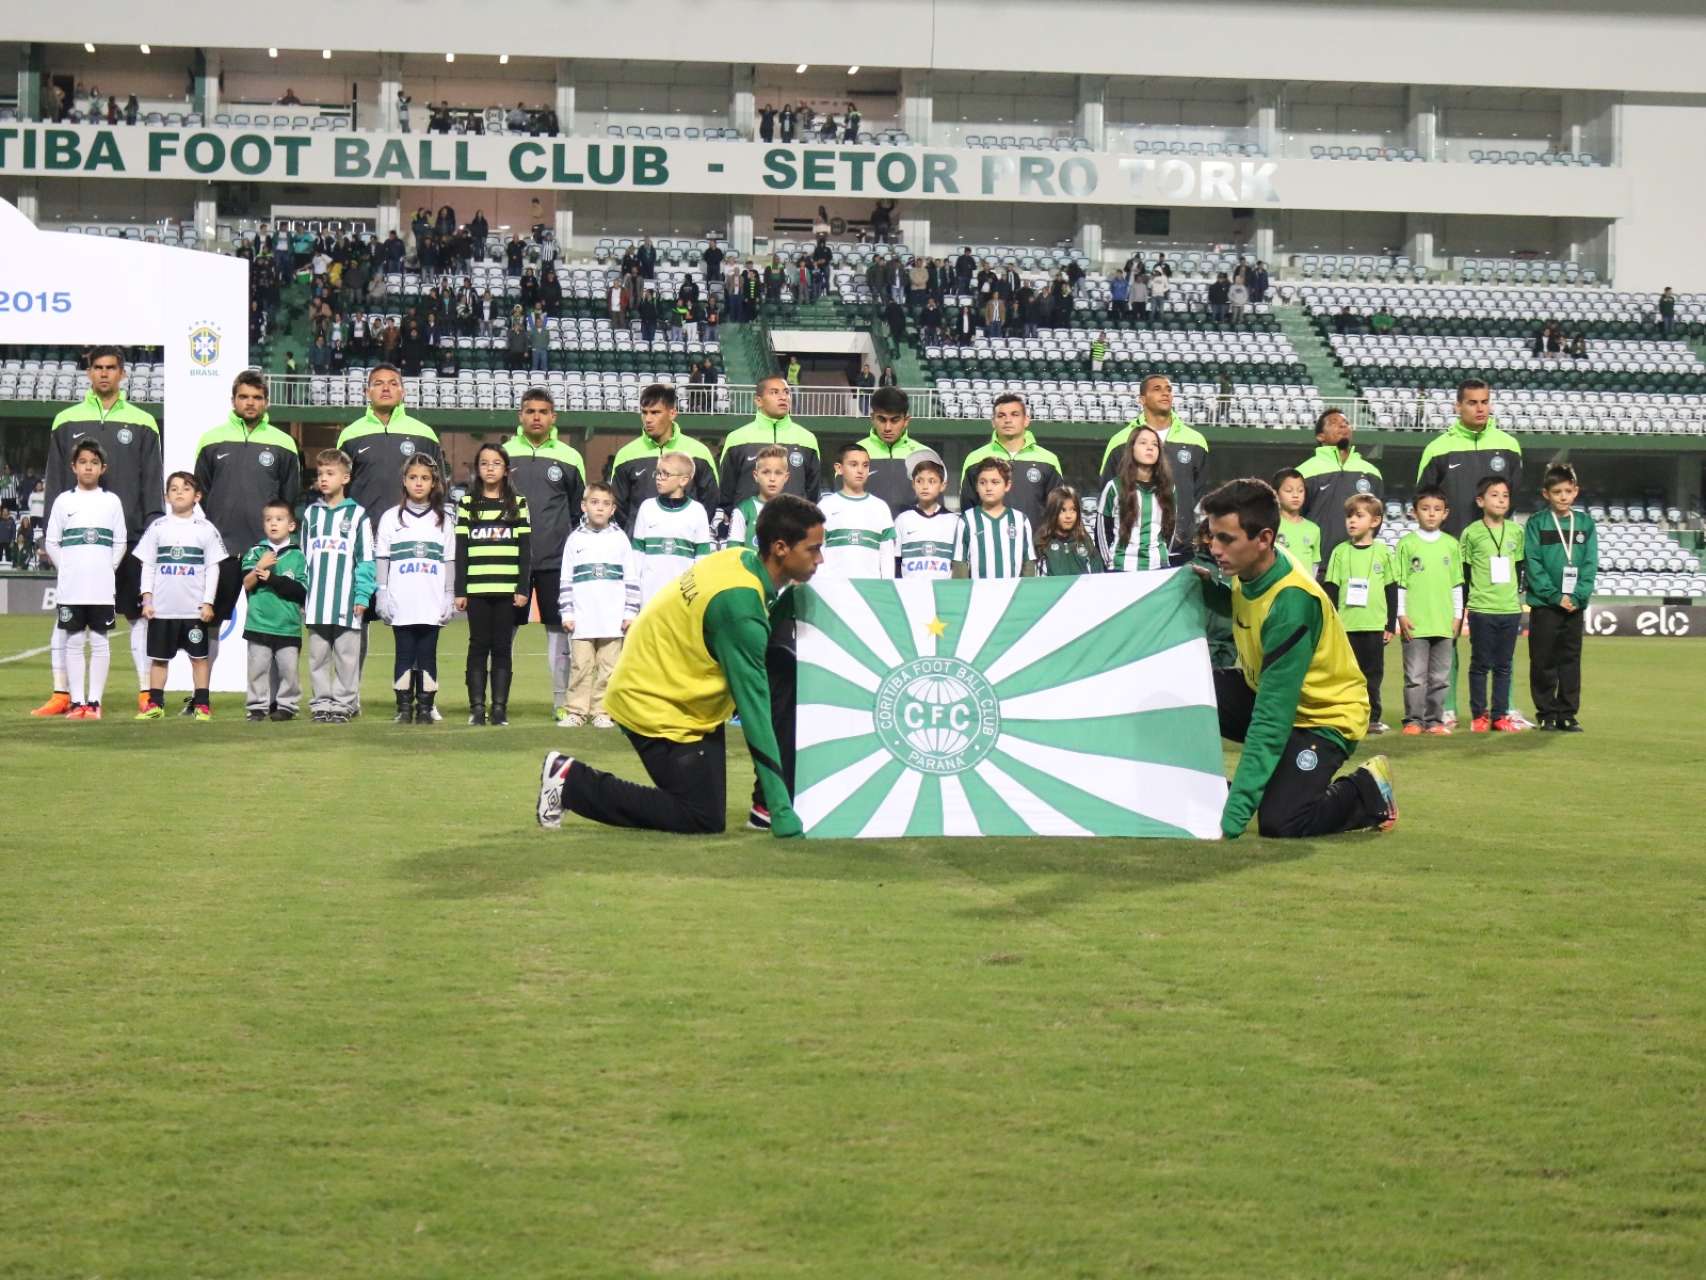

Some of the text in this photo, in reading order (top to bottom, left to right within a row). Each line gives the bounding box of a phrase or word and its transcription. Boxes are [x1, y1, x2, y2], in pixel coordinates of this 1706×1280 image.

[147, 131, 312, 176] FOOT
[333, 137, 487, 182] BALL
[508, 142, 669, 186] CLUB
[762, 148, 960, 194] SETOR
[981, 155, 1098, 197] PRO
[1118, 158, 1281, 203] TORK
[471, 527, 512, 541] CAIXA
[160, 565, 195, 576] CAIXA
[399, 562, 438, 576] CAIXA
[907, 560, 949, 573] CAIXA
[879, 661, 995, 736] CORITIBA FOOT BALL CLUB
[904, 702, 970, 731] CFC
